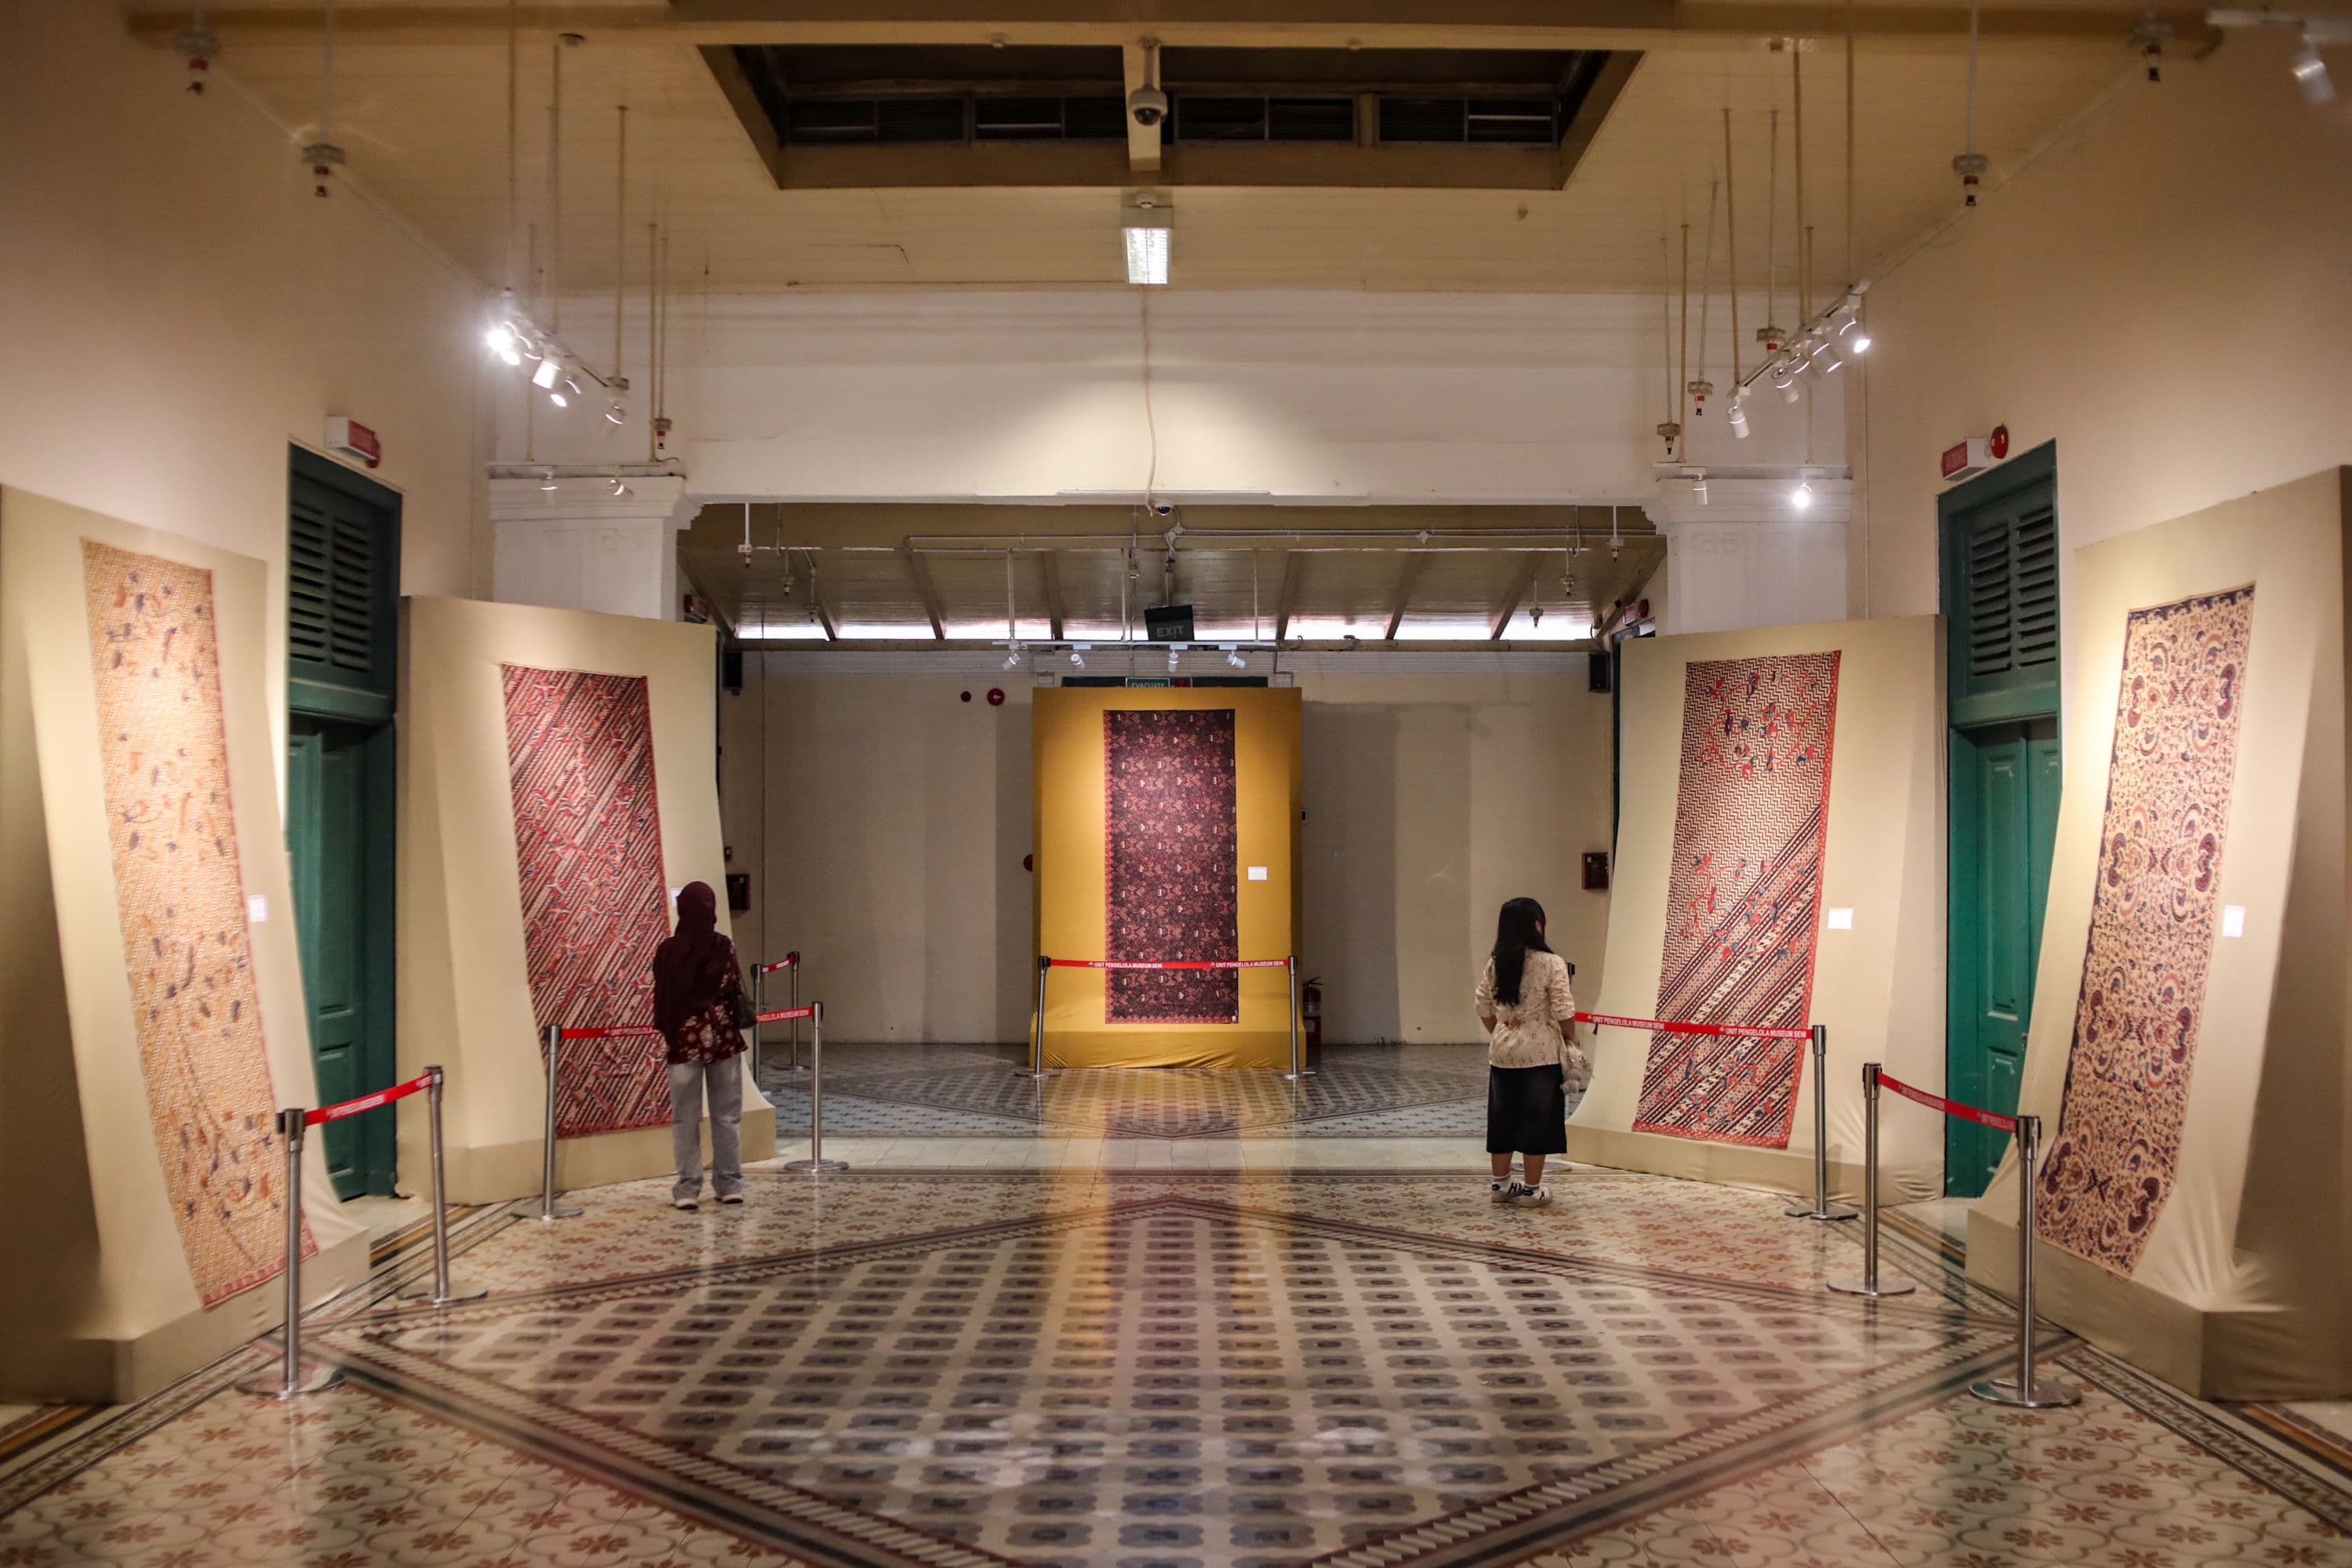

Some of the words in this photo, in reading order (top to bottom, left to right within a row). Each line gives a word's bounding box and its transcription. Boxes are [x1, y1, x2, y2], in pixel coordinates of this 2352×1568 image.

[1156, 626, 1184, 637] EXIT
[779, 1010, 798, 1018] MUSEUM
[1603, 1017, 1632, 1026] PENGELOLA
[1737, 1028, 1770, 1036] PENGELOLA
